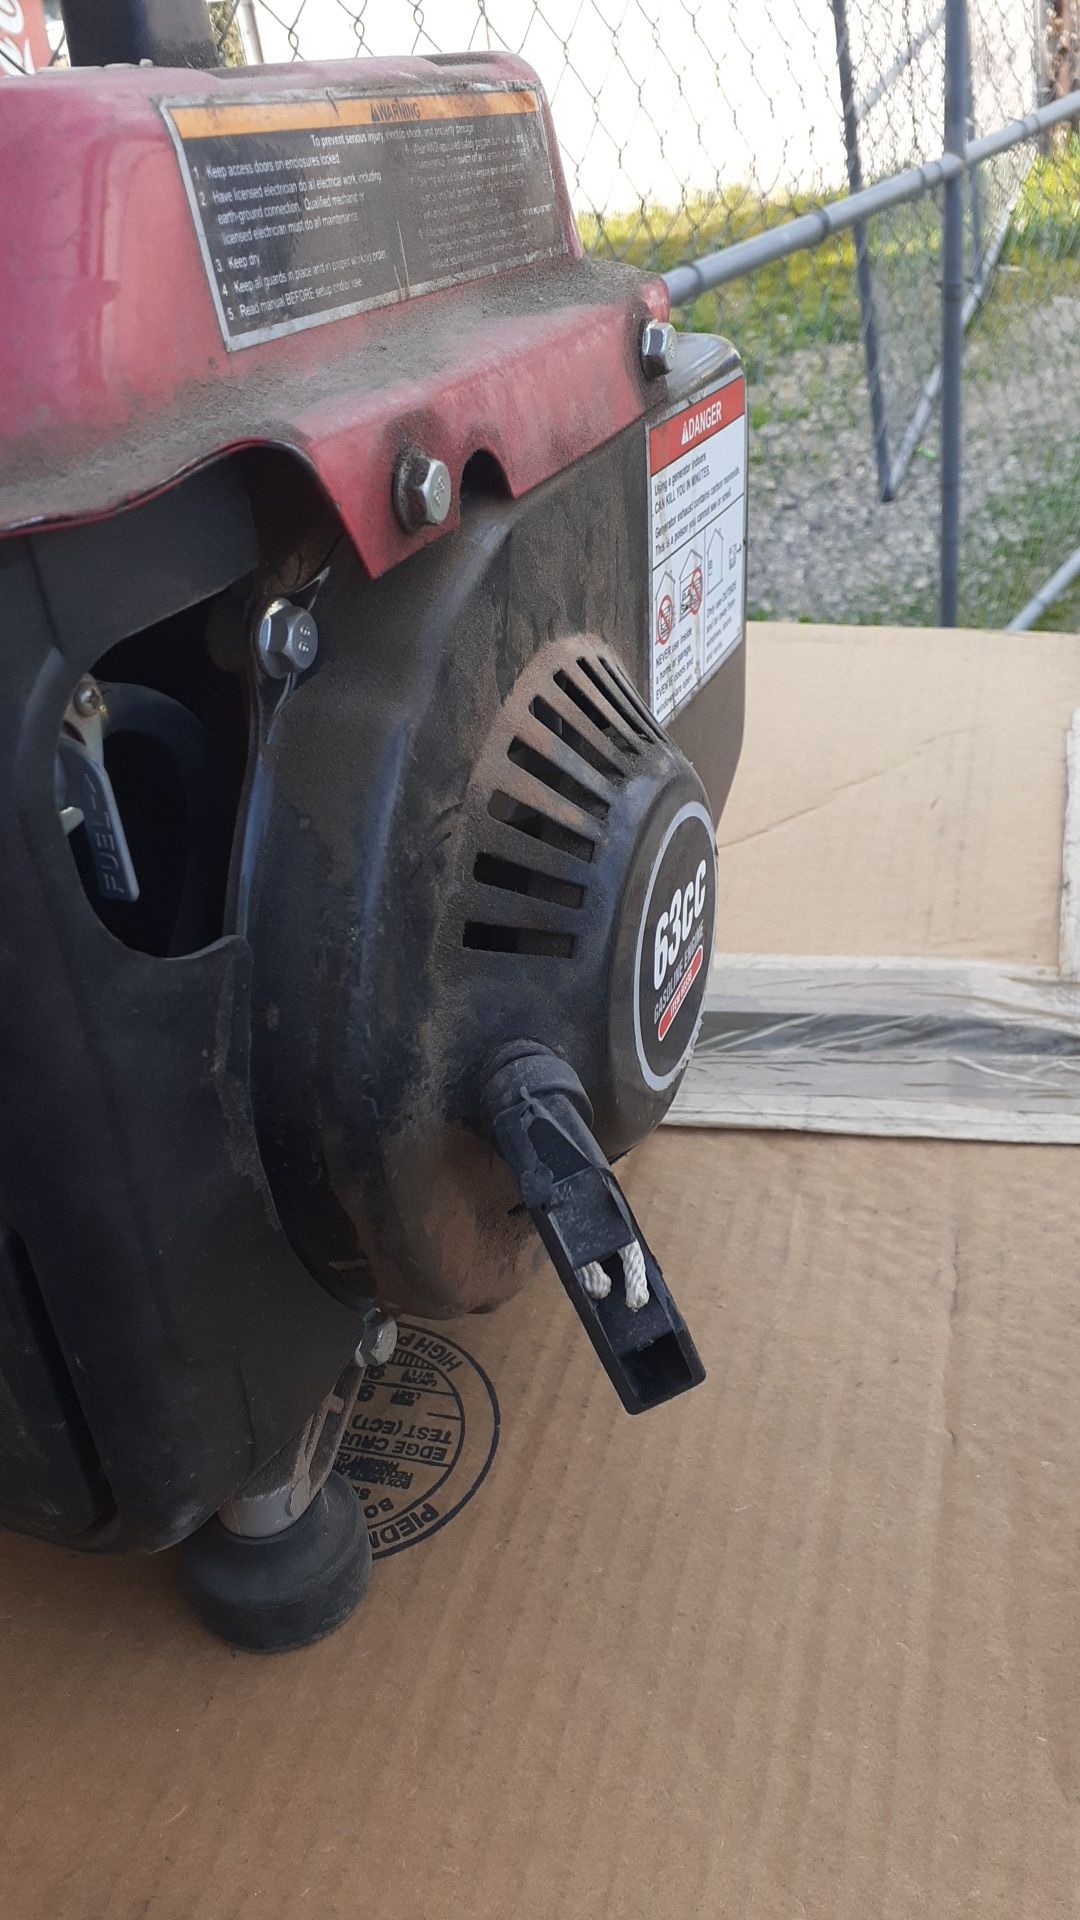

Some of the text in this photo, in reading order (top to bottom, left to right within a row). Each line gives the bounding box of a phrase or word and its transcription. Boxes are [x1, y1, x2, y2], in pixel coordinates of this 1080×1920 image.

[376, 103, 421, 121] WARNING
[310, 134, 318, 147] To
[320, 135, 345, 148] prevent
[344, 133, 367, 144] serious
[206, 163, 226, 179] Keep
[228, 163, 254, 176] access
[254, 158, 274, 173] doors
[285, 154, 320, 168] enclosures
[212, 190, 233, 205] Have
[234, 185, 263, 202] licensed
[264, 180, 302, 198] electrician
[299, 180, 308, 192] do
[308, 176, 316, 190] all
[316, 175, 342, 189] electrical
[217, 205, 263, 225] earth-ground
[304, 193, 331, 211] Qualified
[222, 230, 253, 246] licensed
[253, 223, 288, 242] electrician
[288, 219, 304, 235] must
[304, 218, 314, 232] do
[314, 215, 322, 229] all
[228, 256, 248, 270] Keep
[233, 278, 254, 294] Keep
[254, 275, 263, 289] all
[263, 272, 287, 290] guards
[295, 266, 312, 283] place
[239, 303, 259, 318] Read
[260, 297, 286, 312] manual
[285, 286, 315, 306] BEFORE
[315, 283, 333, 300] setup
[687, 400, 722, 441] DANGER
[654, 477, 668, 496] Using
[672, 464, 692, 487] generator
[691, 453, 708, 471] indoors
[654, 494, 665, 514] CAN
[665, 489, 677, 506] KILL
[676, 482, 686, 498] YOU
[686, 478, 692, 490] IN
[655, 515, 677, 539] Generator
[677, 502, 694, 522] exhaust
[710, 481, 723, 497] carbon
[655, 539, 666, 556] This
[674, 524, 688, 542] poison
[688, 518, 697, 533] you
[697, 507, 711, 524] cannot
[656, 647, 673, 668] NEVER
[656, 684, 671, 700] EVEN
[673, 666, 686, 684] doors
[659, 666, 672, 681] home
[93, 811, 125, 893] FUEL
[654, 957, 684, 1025] GASOLINE
[413, 1335, 463, 1372] HIGH
[352, 1413, 452, 1444] TEST (ECT)
[392, 1440, 448, 1461] EDGE
